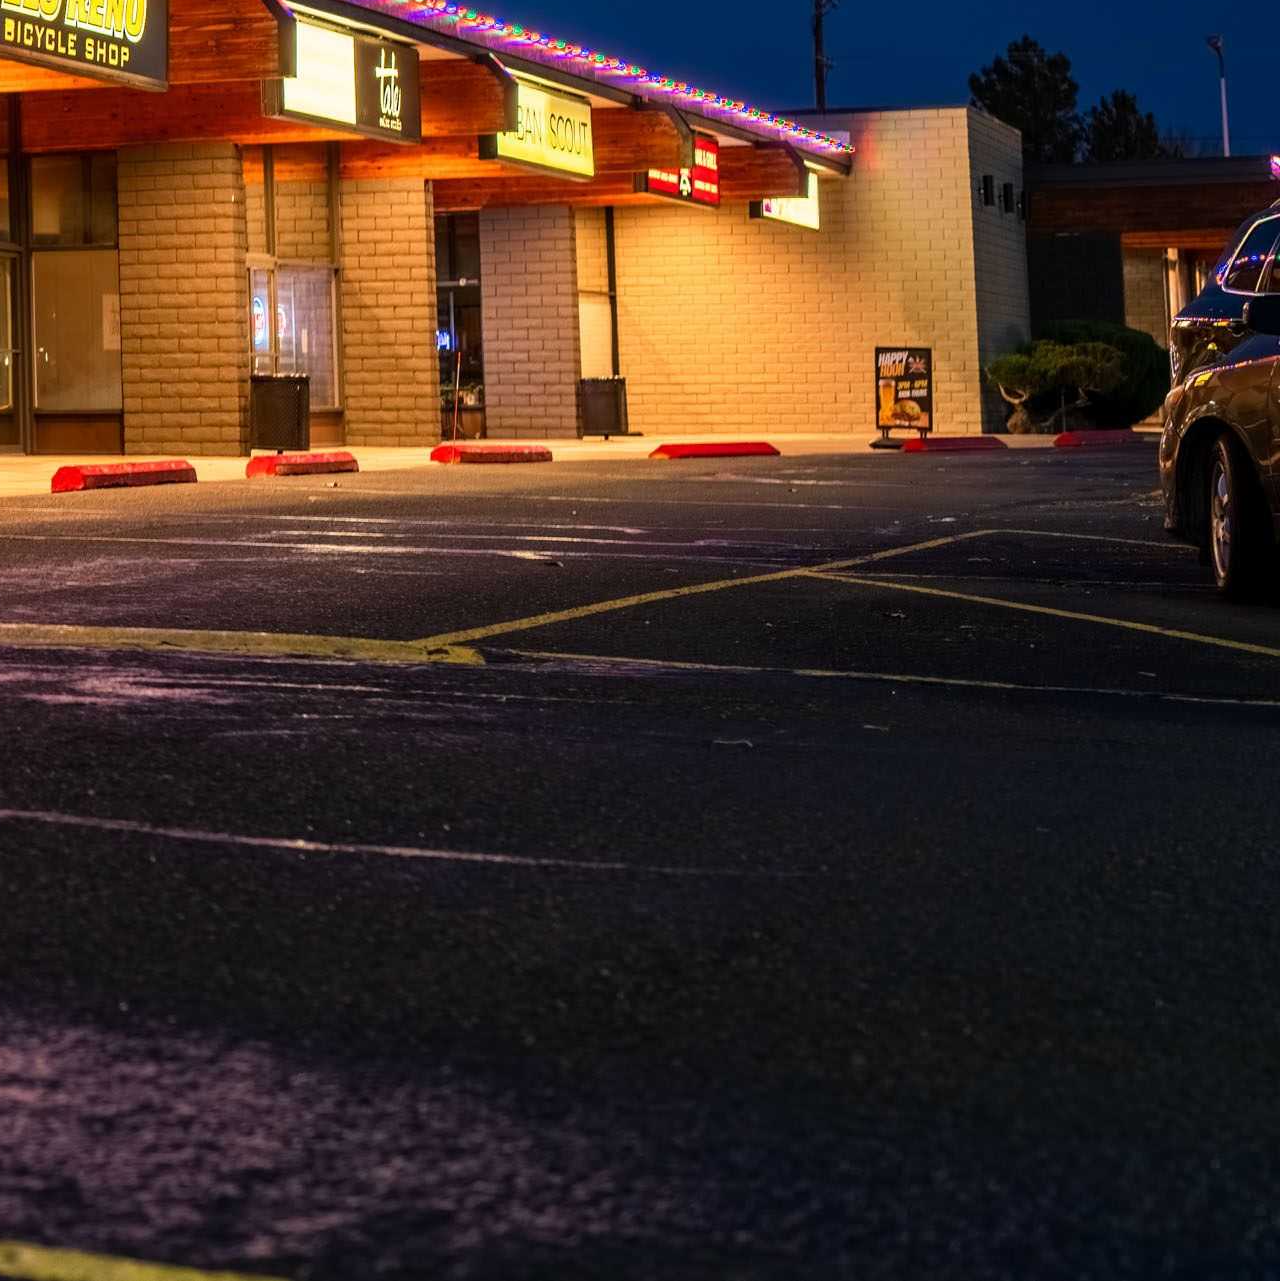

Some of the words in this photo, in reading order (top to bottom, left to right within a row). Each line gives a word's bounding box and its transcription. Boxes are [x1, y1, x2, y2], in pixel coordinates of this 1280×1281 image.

[4, 17, 77, 56] BICYCLE
[85, 38, 130, 68] SHOP
[549, 113, 588, 155] SCOUT
[878, 351, 908, 368] HAPPY
